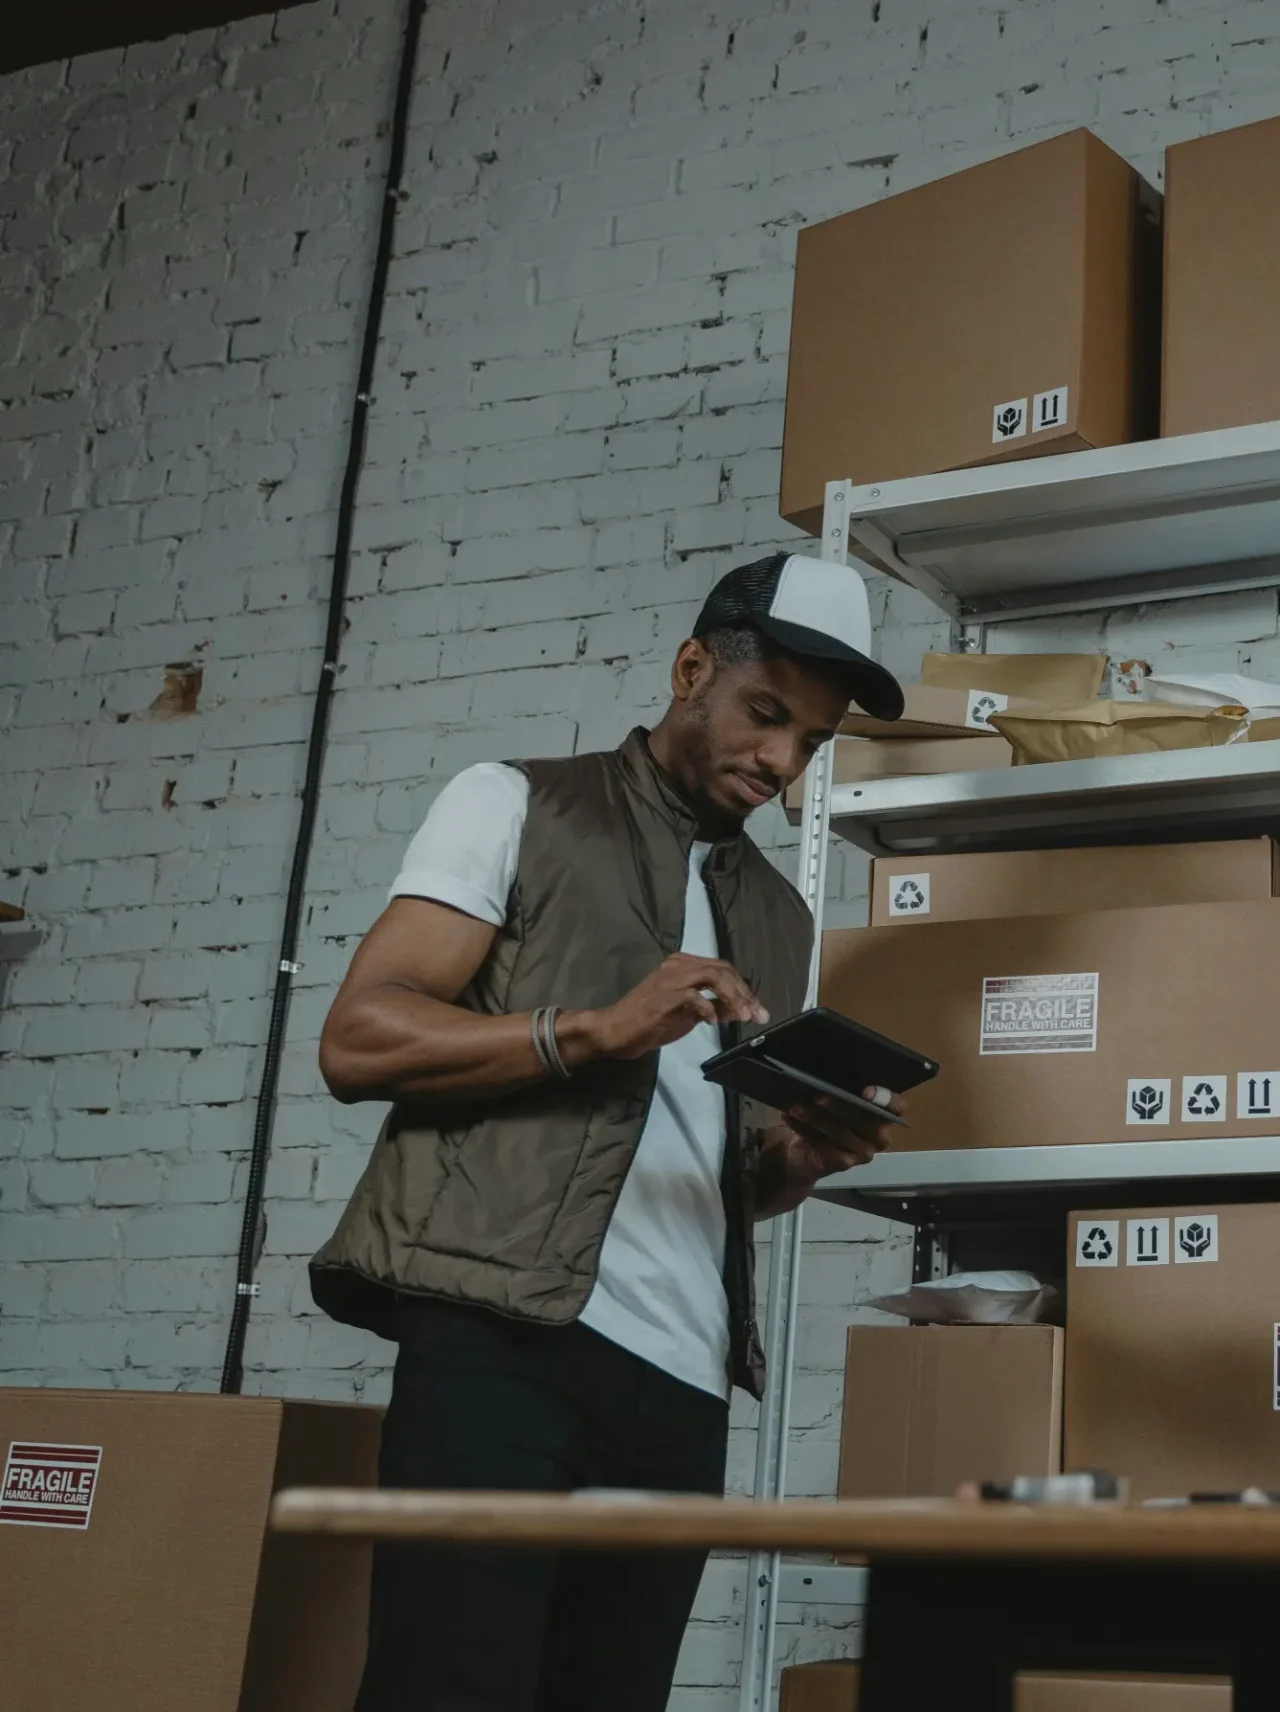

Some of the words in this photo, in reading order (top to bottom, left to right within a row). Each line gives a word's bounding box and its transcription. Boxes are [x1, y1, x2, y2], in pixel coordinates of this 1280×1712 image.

[986, 998, 1091, 1021] FRAGILE
[986, 1021, 1028, 1031] HANDLE
[1031, 1020, 1058, 1030] WITH
[1060, 1019, 1091, 1028] CARE
[6, 1468, 93, 1493] FRAGILE
[5, 1489, 39, 1501] HANDLE
[41, 1491, 62, 1502] WITH
[63, 1493, 89, 1504] CARE
